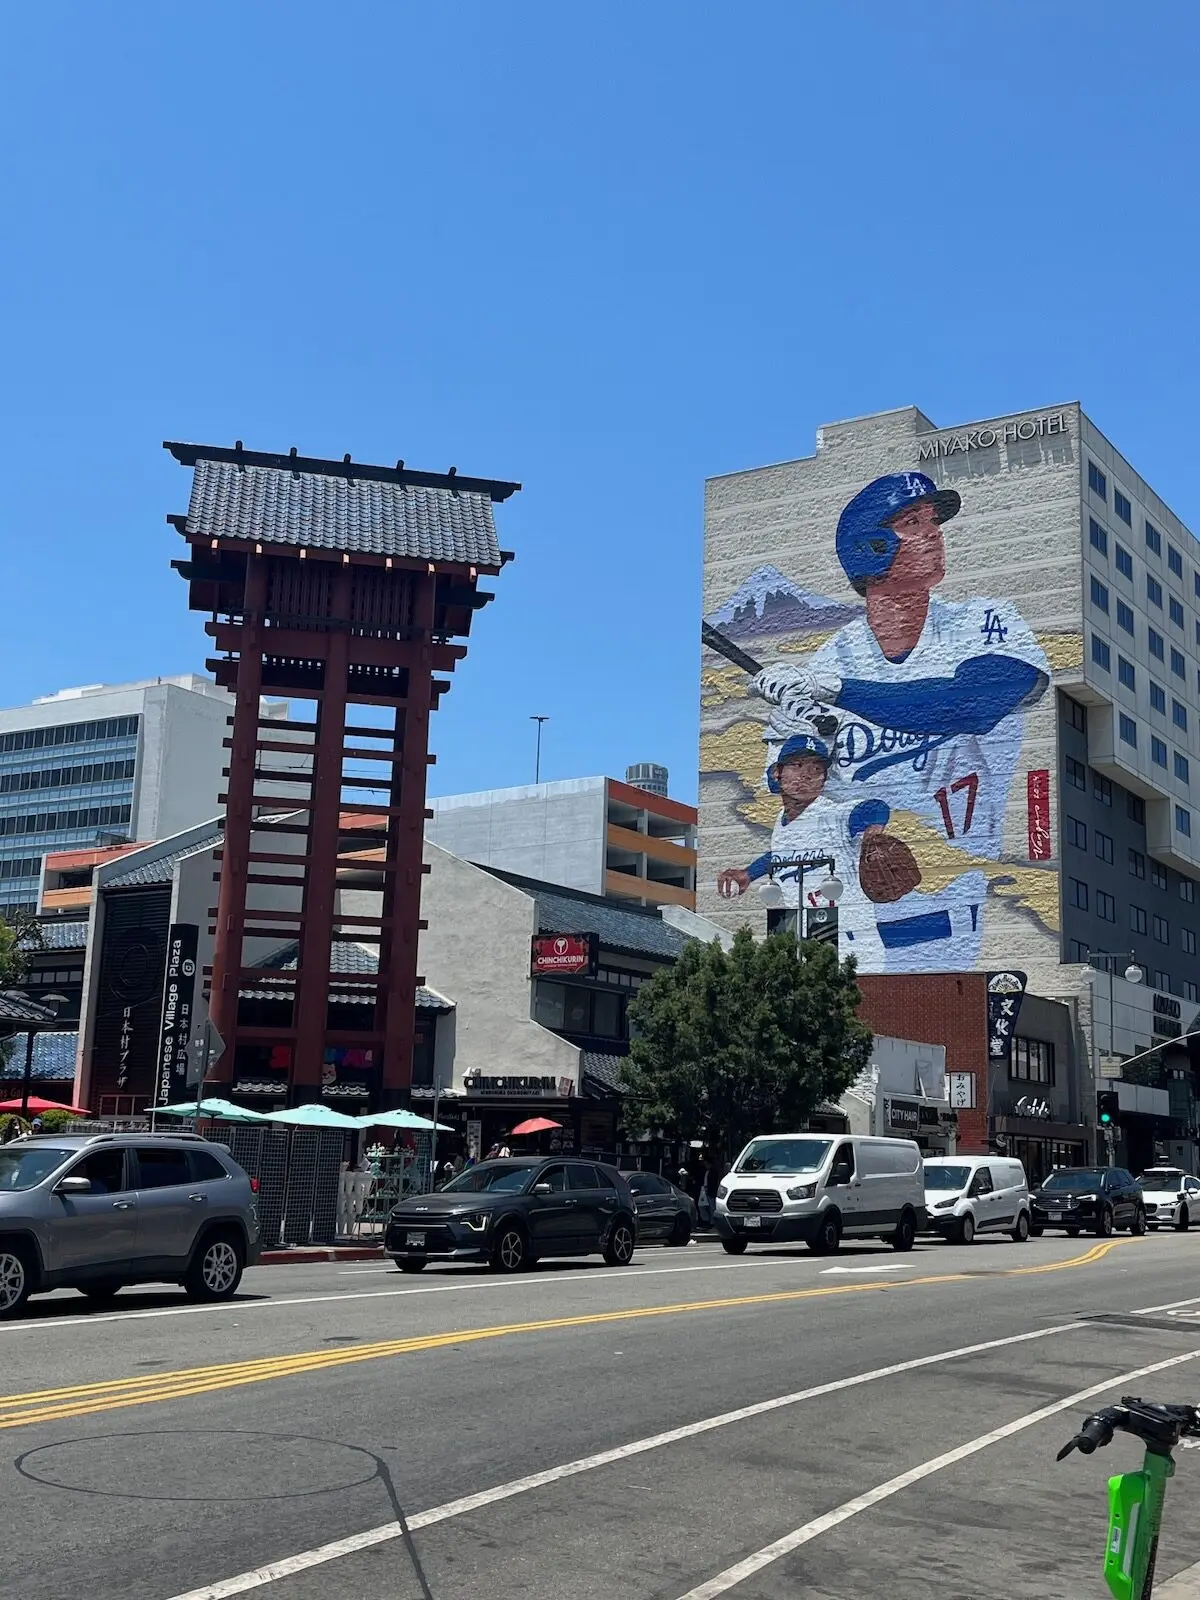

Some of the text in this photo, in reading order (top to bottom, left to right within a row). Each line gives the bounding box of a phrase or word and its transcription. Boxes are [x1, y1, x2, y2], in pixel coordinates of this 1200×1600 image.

[918, 414, 1069, 461] MIYAKO HOTEL
[903, 473, 927, 497] LA
[981, 609, 1008, 645] LA
[933, 772, 979, 839] 17
[537, 955, 584, 965] CHINCHIKURIN
[158, 940, 182, 1106] Japanese Village Plaza
[990, 998, 1015, 1056] 文化堂
[116, 1006, 133, 1088] 日本村プラザ
[956, 1074, 966, 1106] おみやげ
[891, 1108, 904, 1120] CITY
[904, 1109, 918, 1121] HAIR
